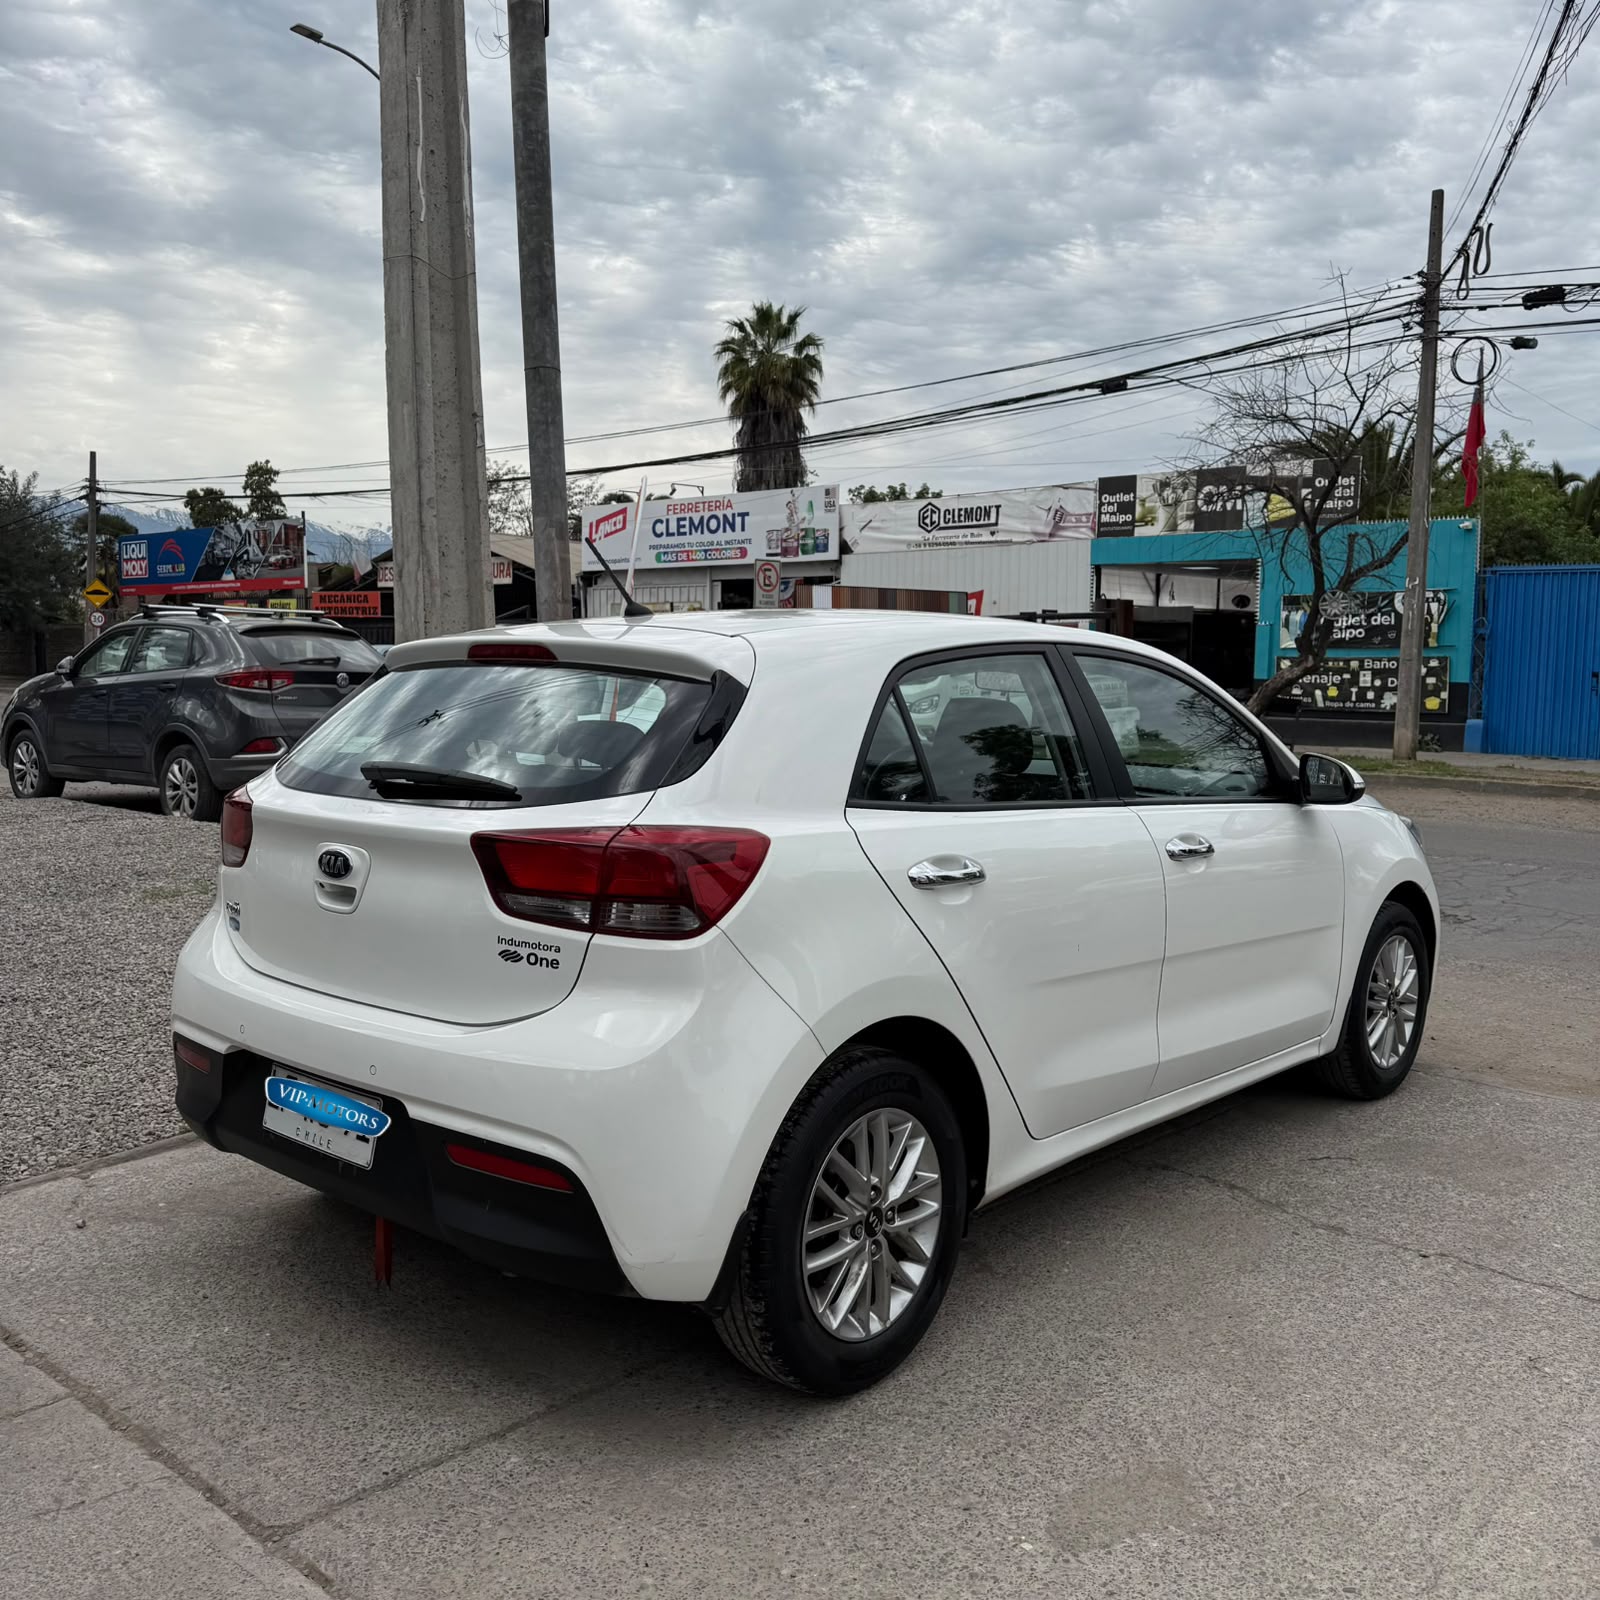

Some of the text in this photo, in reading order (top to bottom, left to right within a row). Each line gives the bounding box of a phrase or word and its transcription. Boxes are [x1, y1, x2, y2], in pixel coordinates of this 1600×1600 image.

[1315, 475, 1356, 487] Olet
[1101, 492, 1135, 503] Outlet
[1334, 486, 1354, 497] del
[666, 497, 734, 516] FERRETERÍA
[824, 500, 836, 509] USA
[1101, 503, 1118, 513] del
[943, 504, 1002, 526] CLEMONT
[1101, 513, 1133, 524] Maipo
[652, 512, 750, 538] CLEMONT
[123, 543, 147, 560] LIQUI
[648, 541, 686, 551] PREPARAMOS
[687, 541, 695, 549] TU
[696, 540, 715, 548] COLOR
[724, 538, 753, 546] INSTANTE
[661, 550, 741, 561] MÁS DE 1400 COLORES
[123, 560, 148, 576] MOLY
[92, 614, 103, 623] 30
[1371, 612, 1395, 626] del
[1330, 626, 1366, 641] aipo
[1364, 658, 1398, 669] Baño
[1299, 672, 1341, 686] enaje
[1345, 700, 1354, 708] de
[320, 853, 346, 875] KIA
[497, 935, 561, 954] Indumotora
[526, 952, 560, 970] One
[295, 1127, 333, 1150] CHILE
